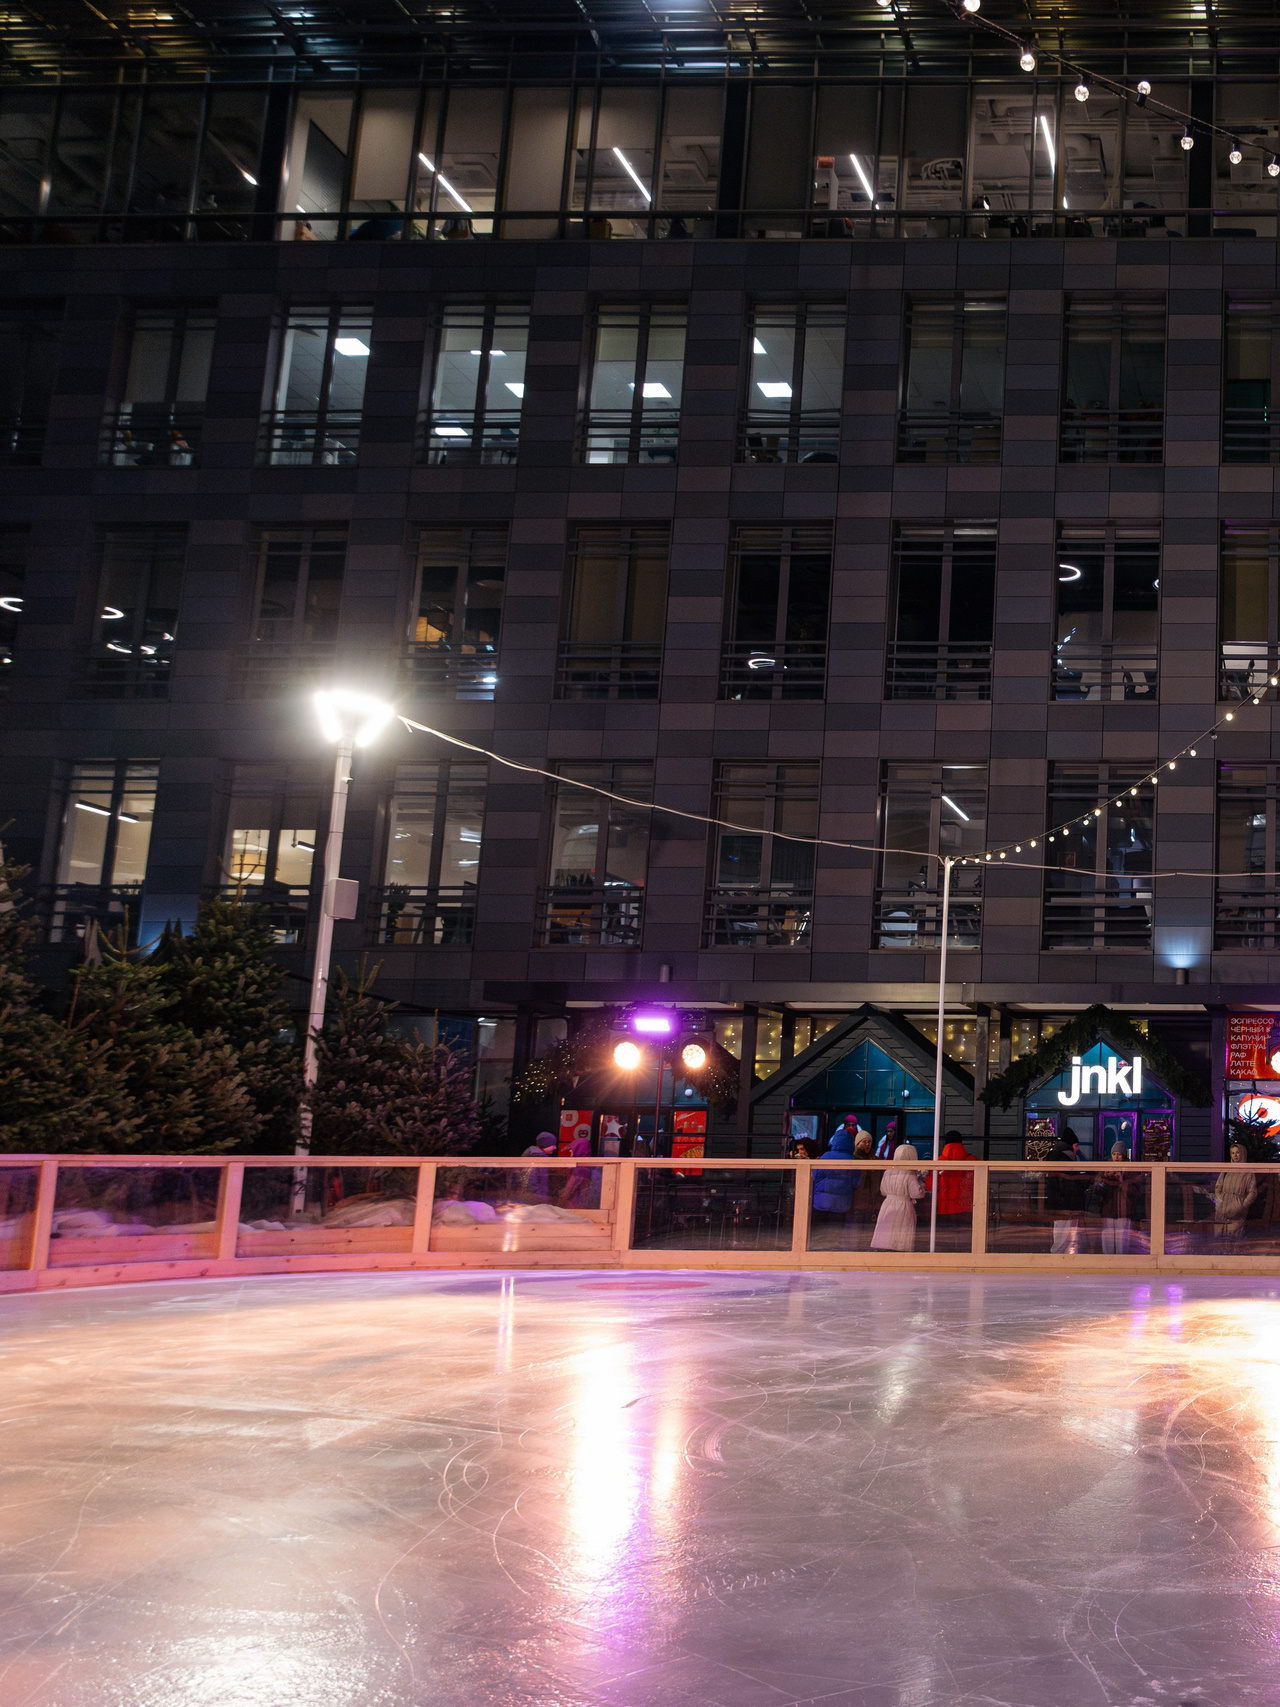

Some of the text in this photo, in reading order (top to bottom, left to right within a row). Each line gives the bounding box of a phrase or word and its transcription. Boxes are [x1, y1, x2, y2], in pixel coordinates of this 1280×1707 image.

[1230, 1017, 1275, 1025] ЭСПРЕССО
[1230, 1025, 1265, 1033] ЧЁРНЫЙ
[1230, 1034, 1272, 1042] КАПУЧИН
[1057, 1056, 1142, 1106] jnkl
